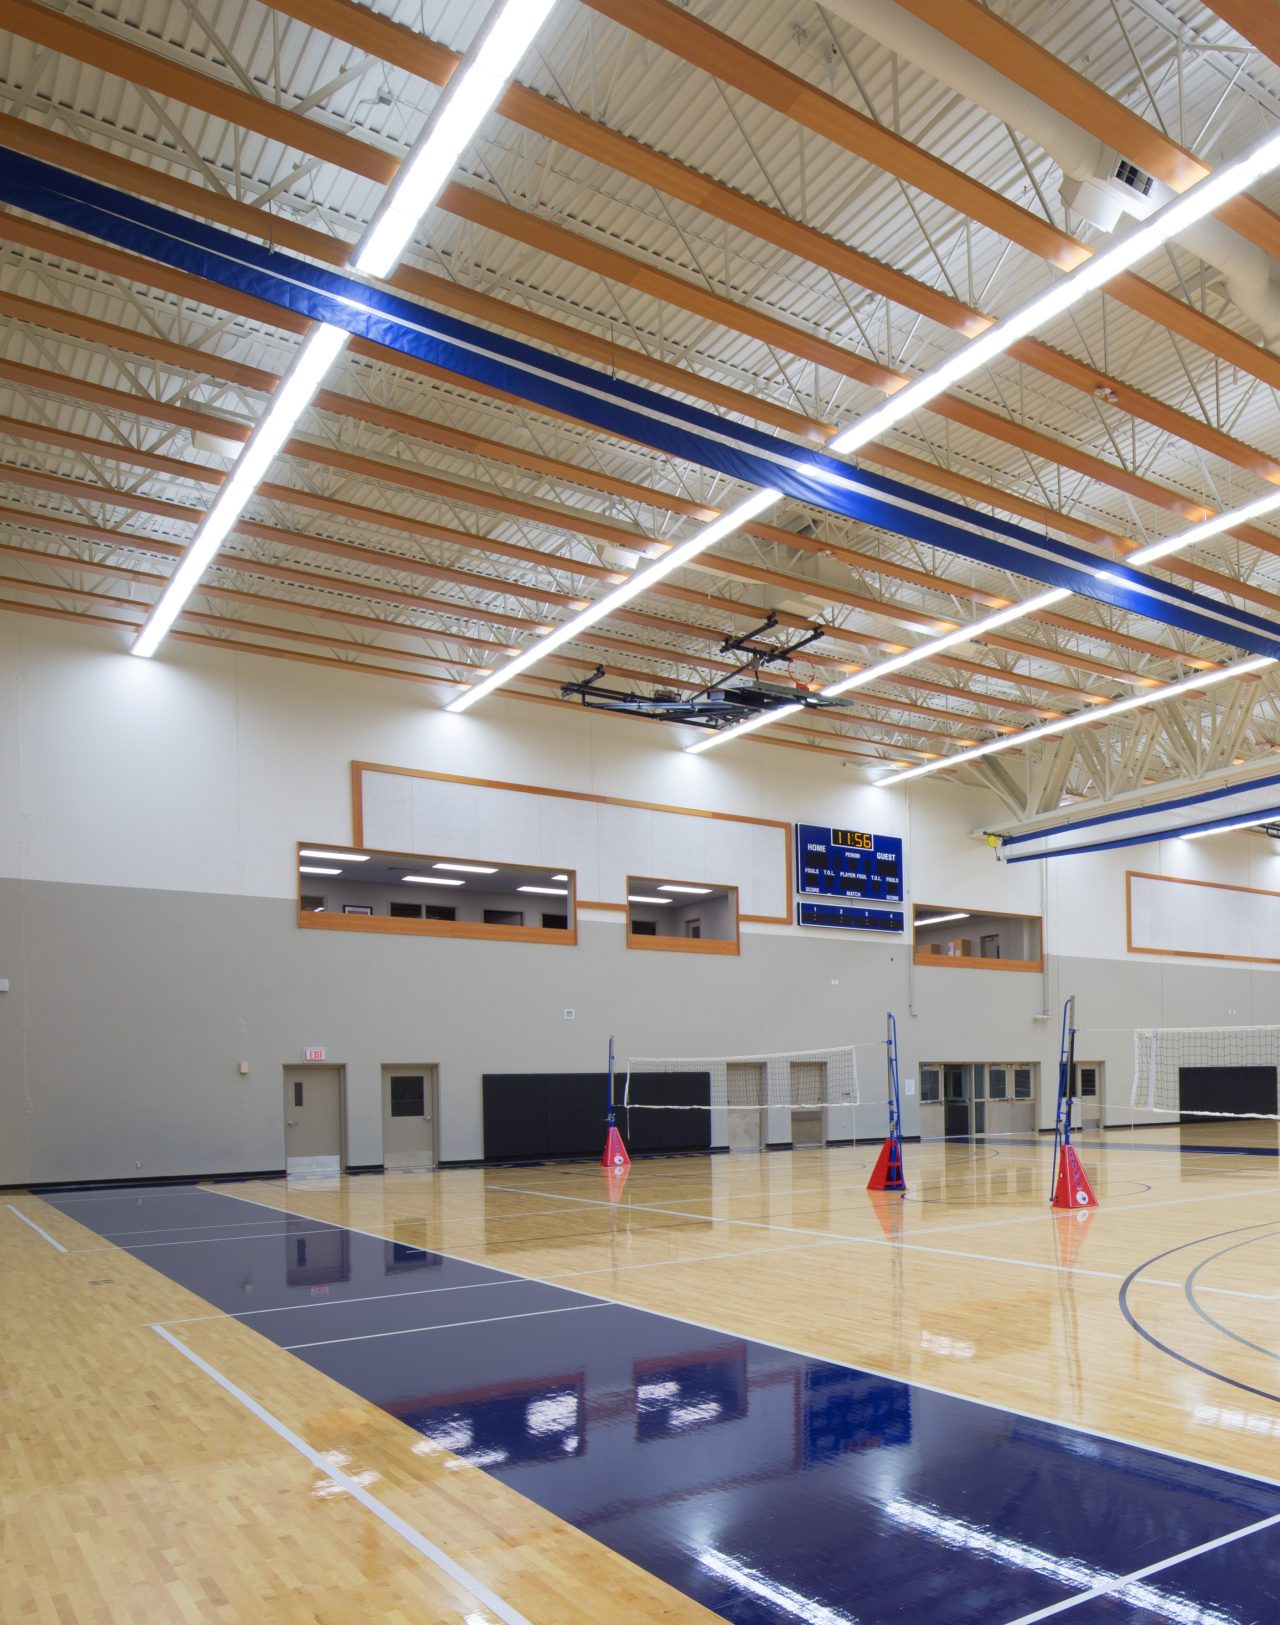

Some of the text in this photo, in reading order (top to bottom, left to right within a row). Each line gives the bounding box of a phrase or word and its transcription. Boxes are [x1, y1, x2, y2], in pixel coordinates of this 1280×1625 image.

[838, 831, 871, 848] 11:56
[808, 844, 826, 852] HOME
[877, 852, 896, 861] GUEST
[310, 1050, 322, 1059] EXIT
